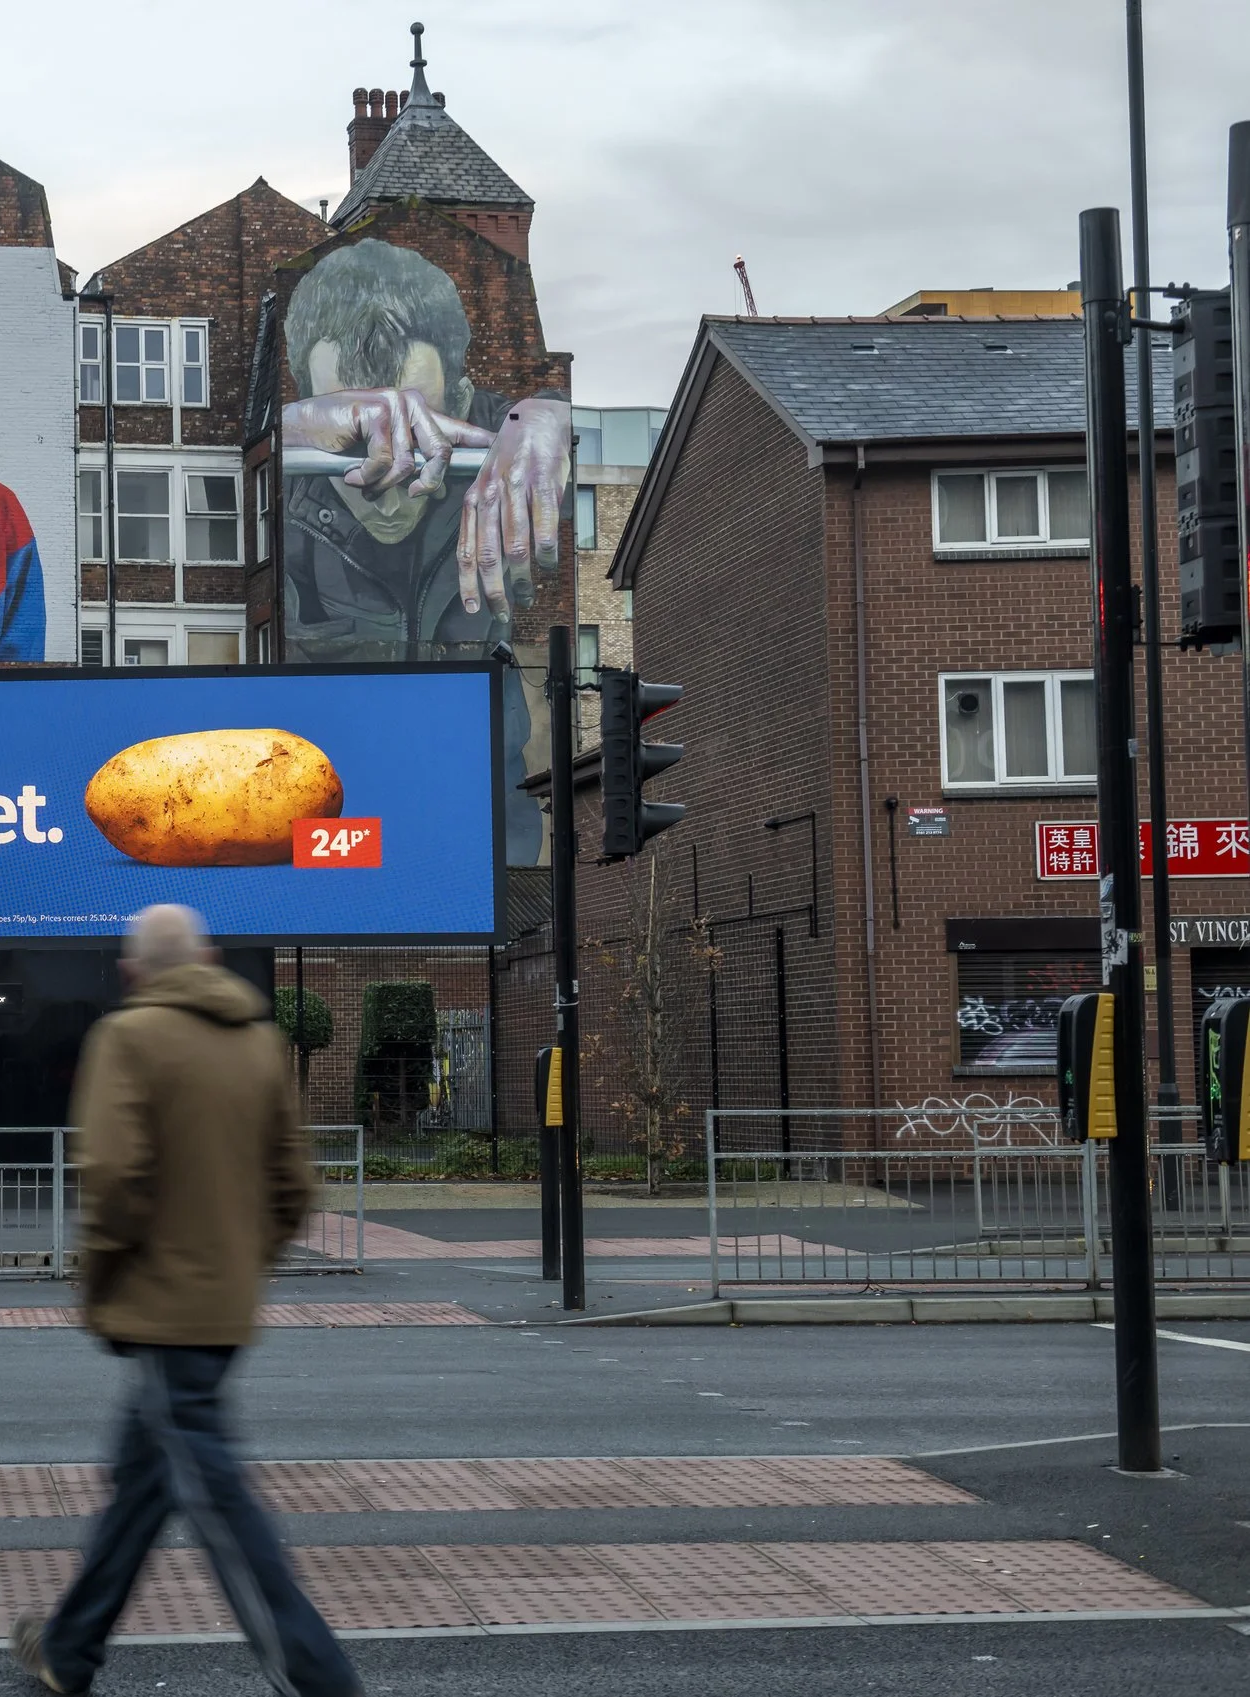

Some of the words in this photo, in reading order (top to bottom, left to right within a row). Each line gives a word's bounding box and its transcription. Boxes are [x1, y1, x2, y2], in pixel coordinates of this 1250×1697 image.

[913, 807, 944, 815] WARNING
[40, 914, 62, 922] Prices
[62, 914, 88, 922] correct
